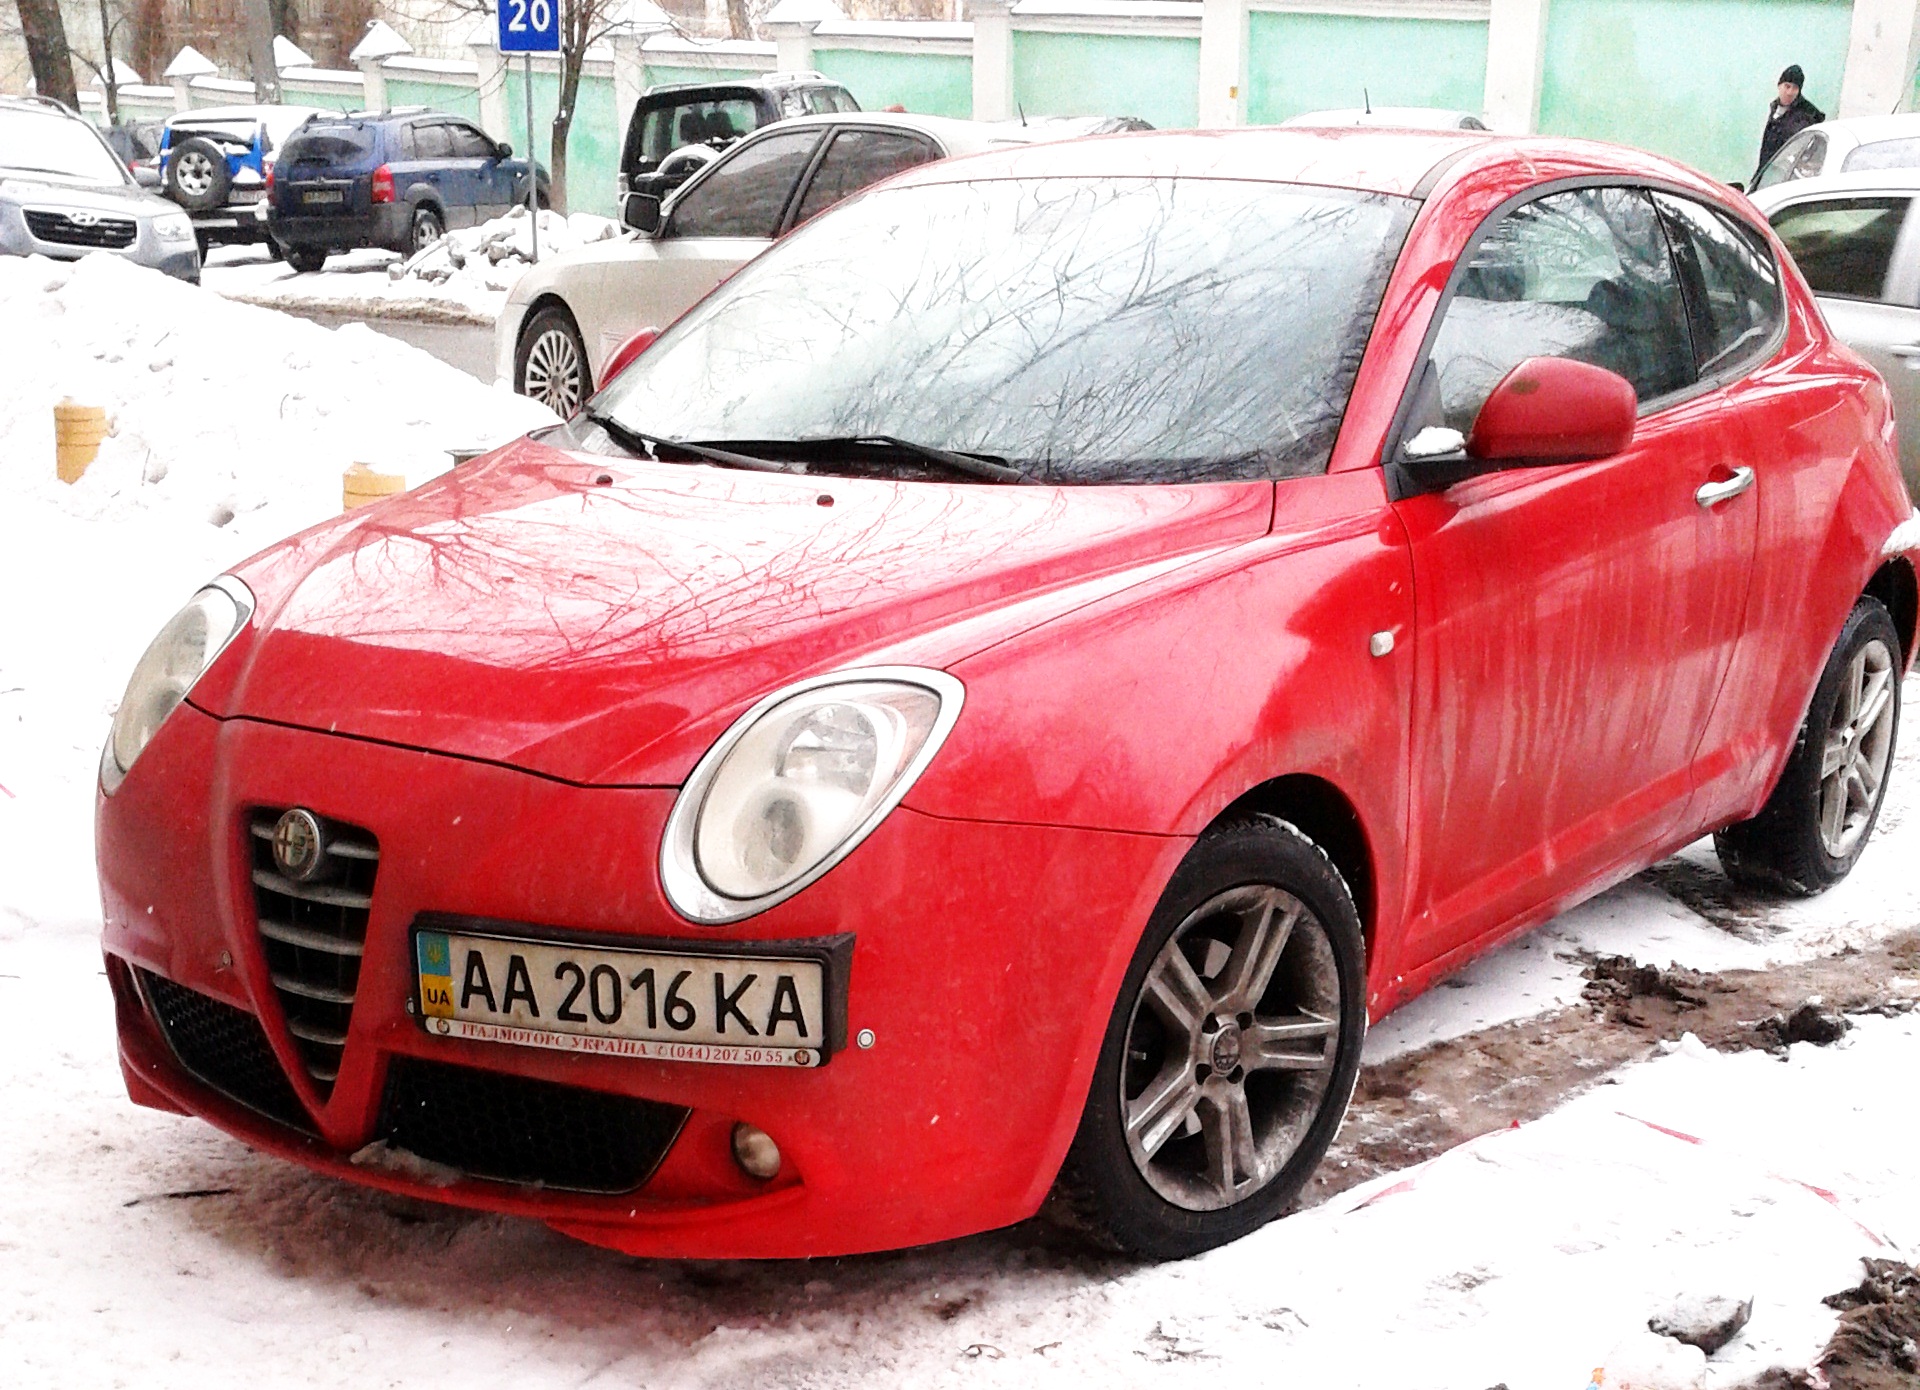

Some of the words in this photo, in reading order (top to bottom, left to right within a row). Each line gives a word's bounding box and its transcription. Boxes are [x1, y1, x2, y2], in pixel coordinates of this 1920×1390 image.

[508, 0, 550, 32] 20
[427, 987, 451, 1007] UA
[461, 950, 540, 1018] AA
[554, 961, 697, 1031] 2016
[714, 972, 808, 1038] KA
[713, 1048, 739, 1061] 207
[743, 1049, 762, 1062] 50
[765, 1051, 783, 1063] 55
